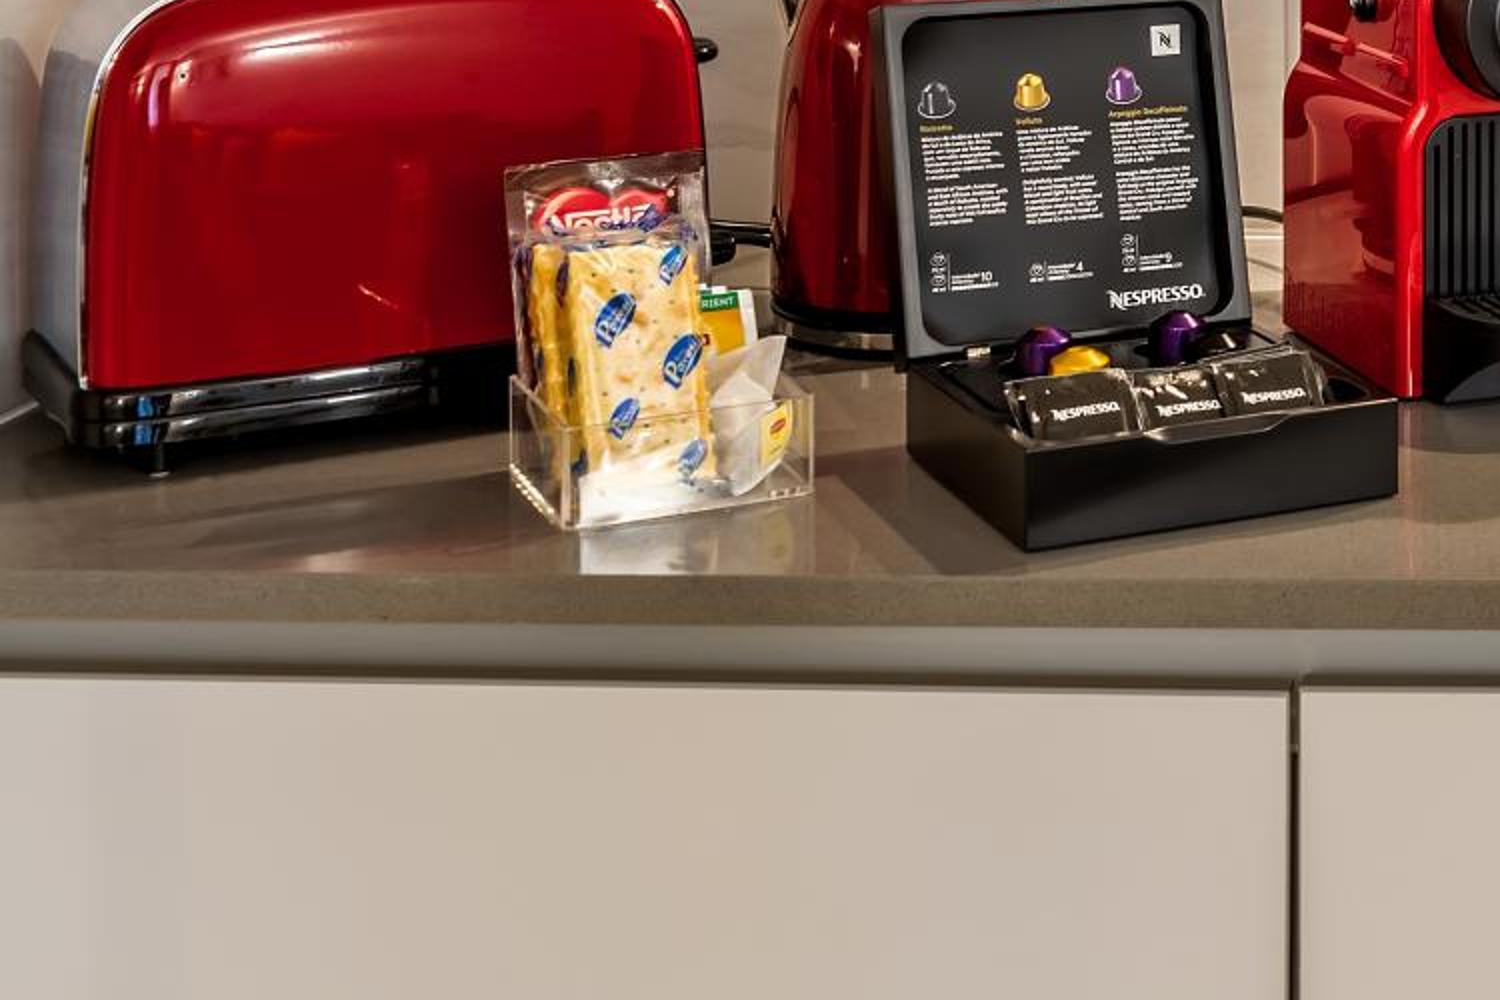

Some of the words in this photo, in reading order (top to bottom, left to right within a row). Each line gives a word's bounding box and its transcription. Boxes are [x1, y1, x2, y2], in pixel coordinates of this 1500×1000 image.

[1075, 260, 1085, 272] 4
[981, 271, 993, 282] 10
[1107, 283, 1202, 310] NESPRESSO
[1051, 402, 1121, 422] NESPRESSO
[1155, 399, 1222, 417] NESPRESSO
